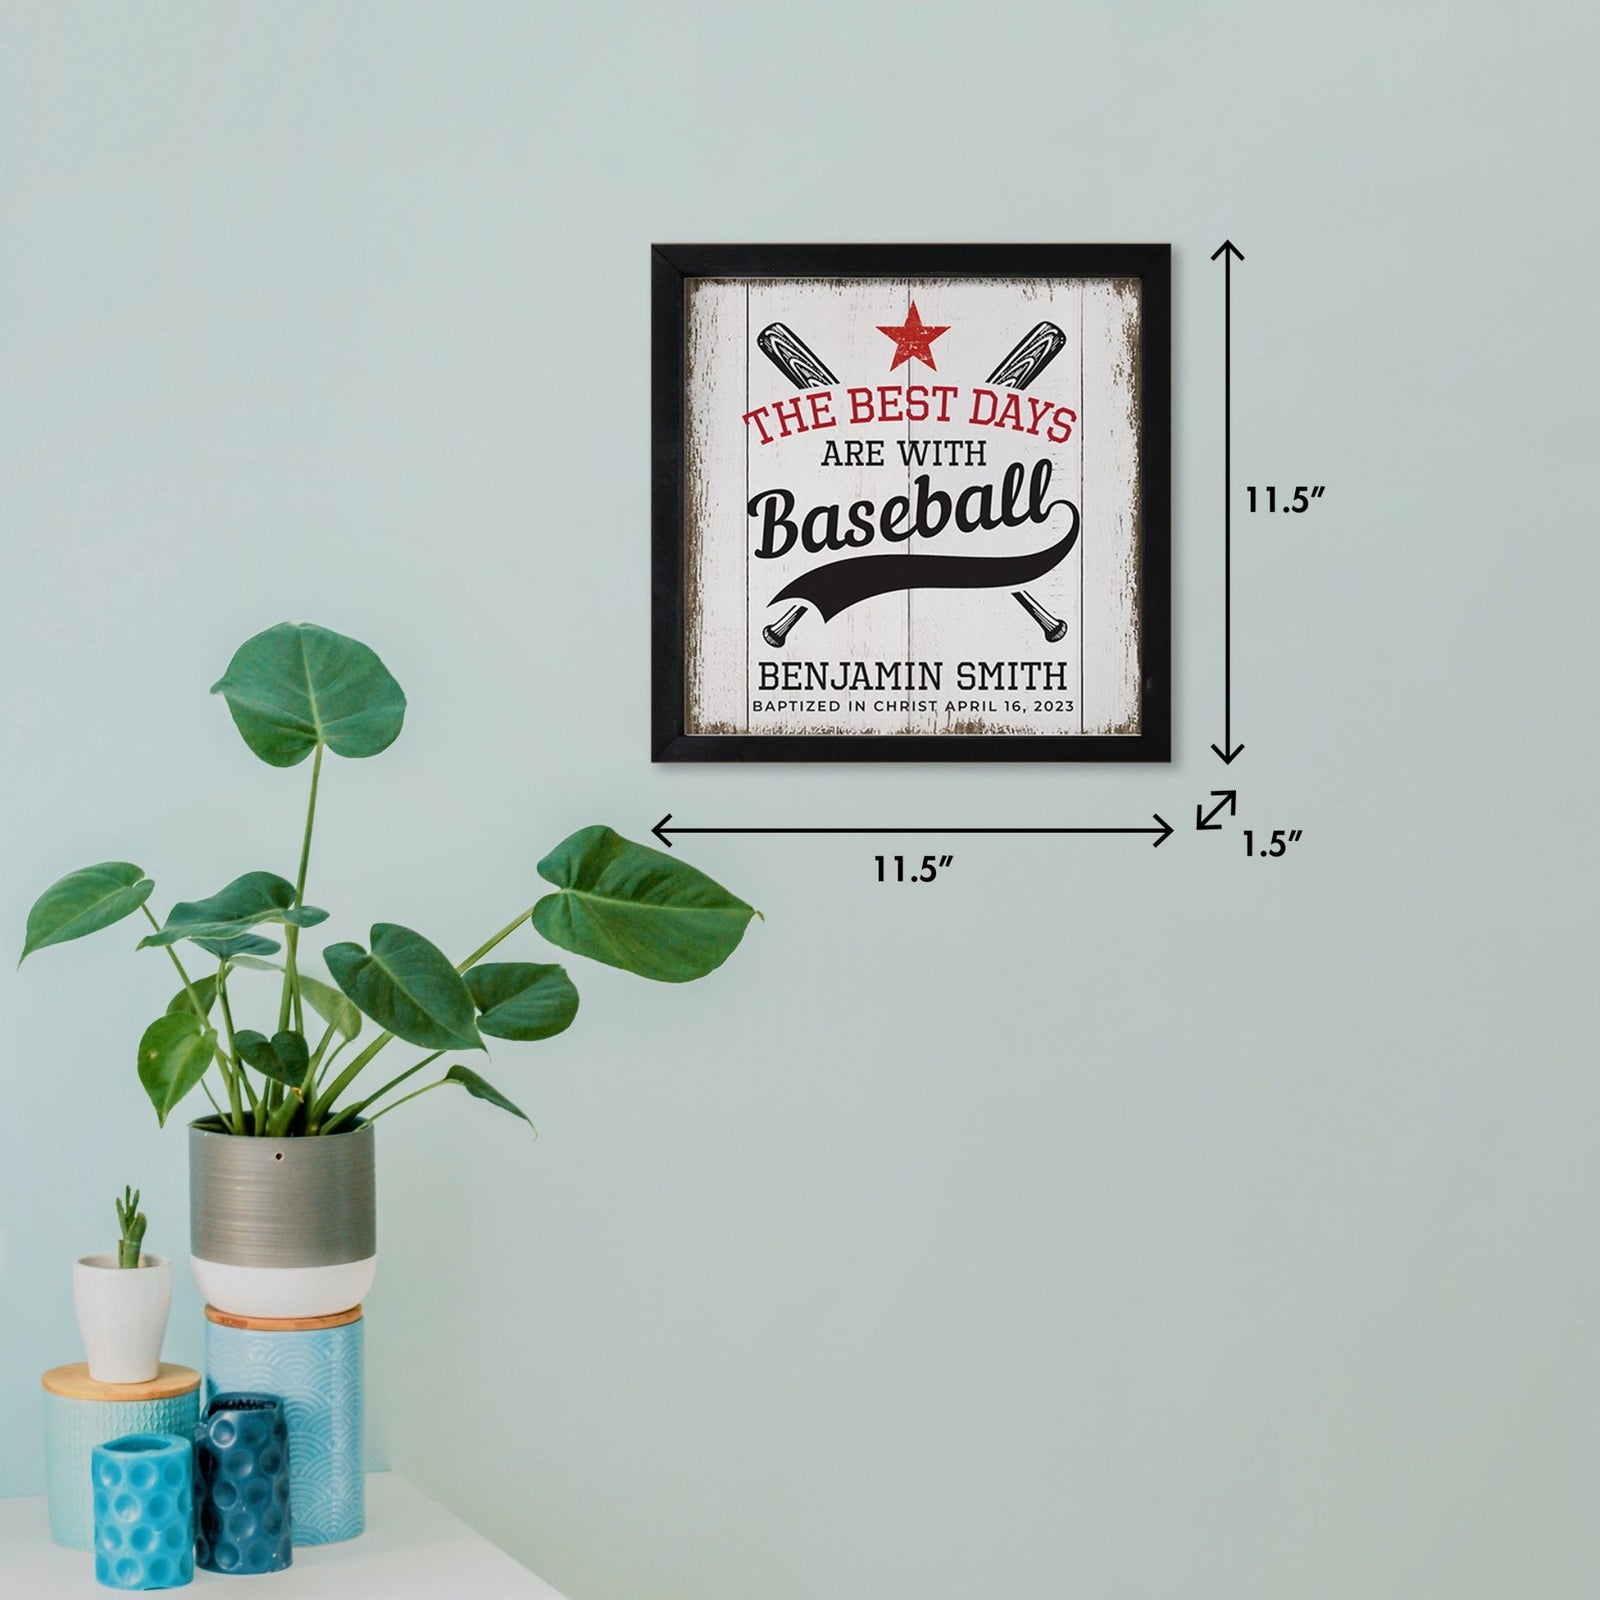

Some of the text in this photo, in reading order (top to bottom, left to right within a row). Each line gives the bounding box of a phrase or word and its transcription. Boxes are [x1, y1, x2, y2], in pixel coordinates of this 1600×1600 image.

[743, 385, 1077, 445] THE BEST DAYS
[820, 440, 987, 467] ARE WITH
[747, 458, 1055, 559] Baseball
[758, 661, 1068, 691] BENJAMIN SMITH
[752, 700, 1074, 714] BAPTIZED IN CHRIST APRIL 16, 2023
